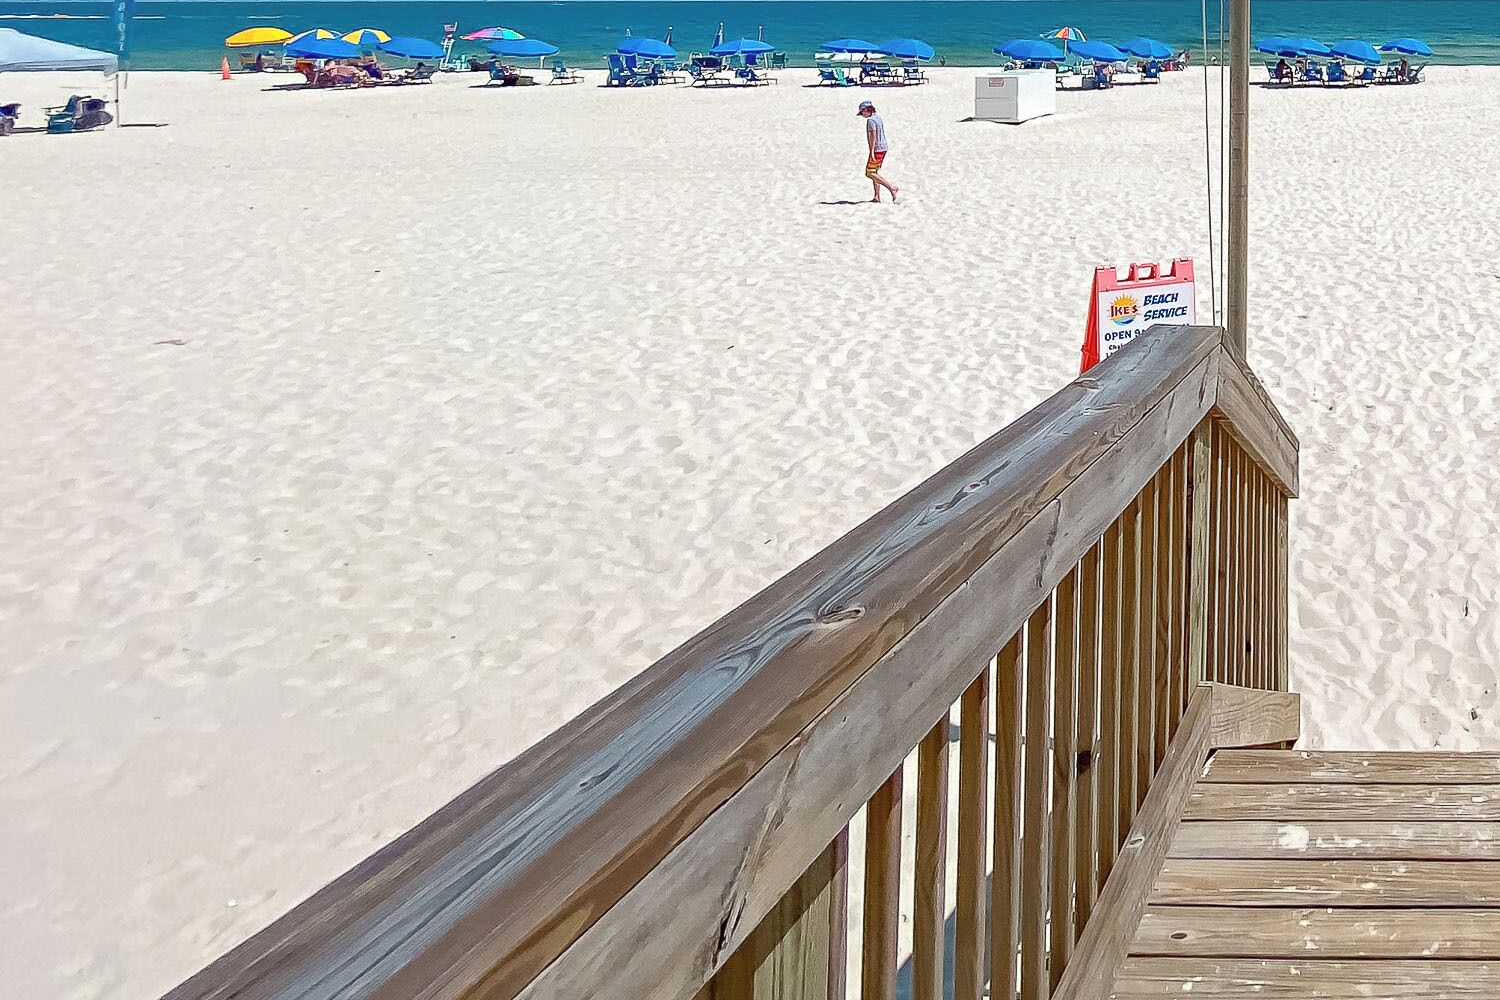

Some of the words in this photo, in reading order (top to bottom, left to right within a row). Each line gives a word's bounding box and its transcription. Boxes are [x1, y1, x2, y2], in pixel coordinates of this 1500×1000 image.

[1143, 293, 1179, 306] BEACH
[1143, 306, 1188, 321] SERVICE
[1104, 330, 1132, 342] OPEN
